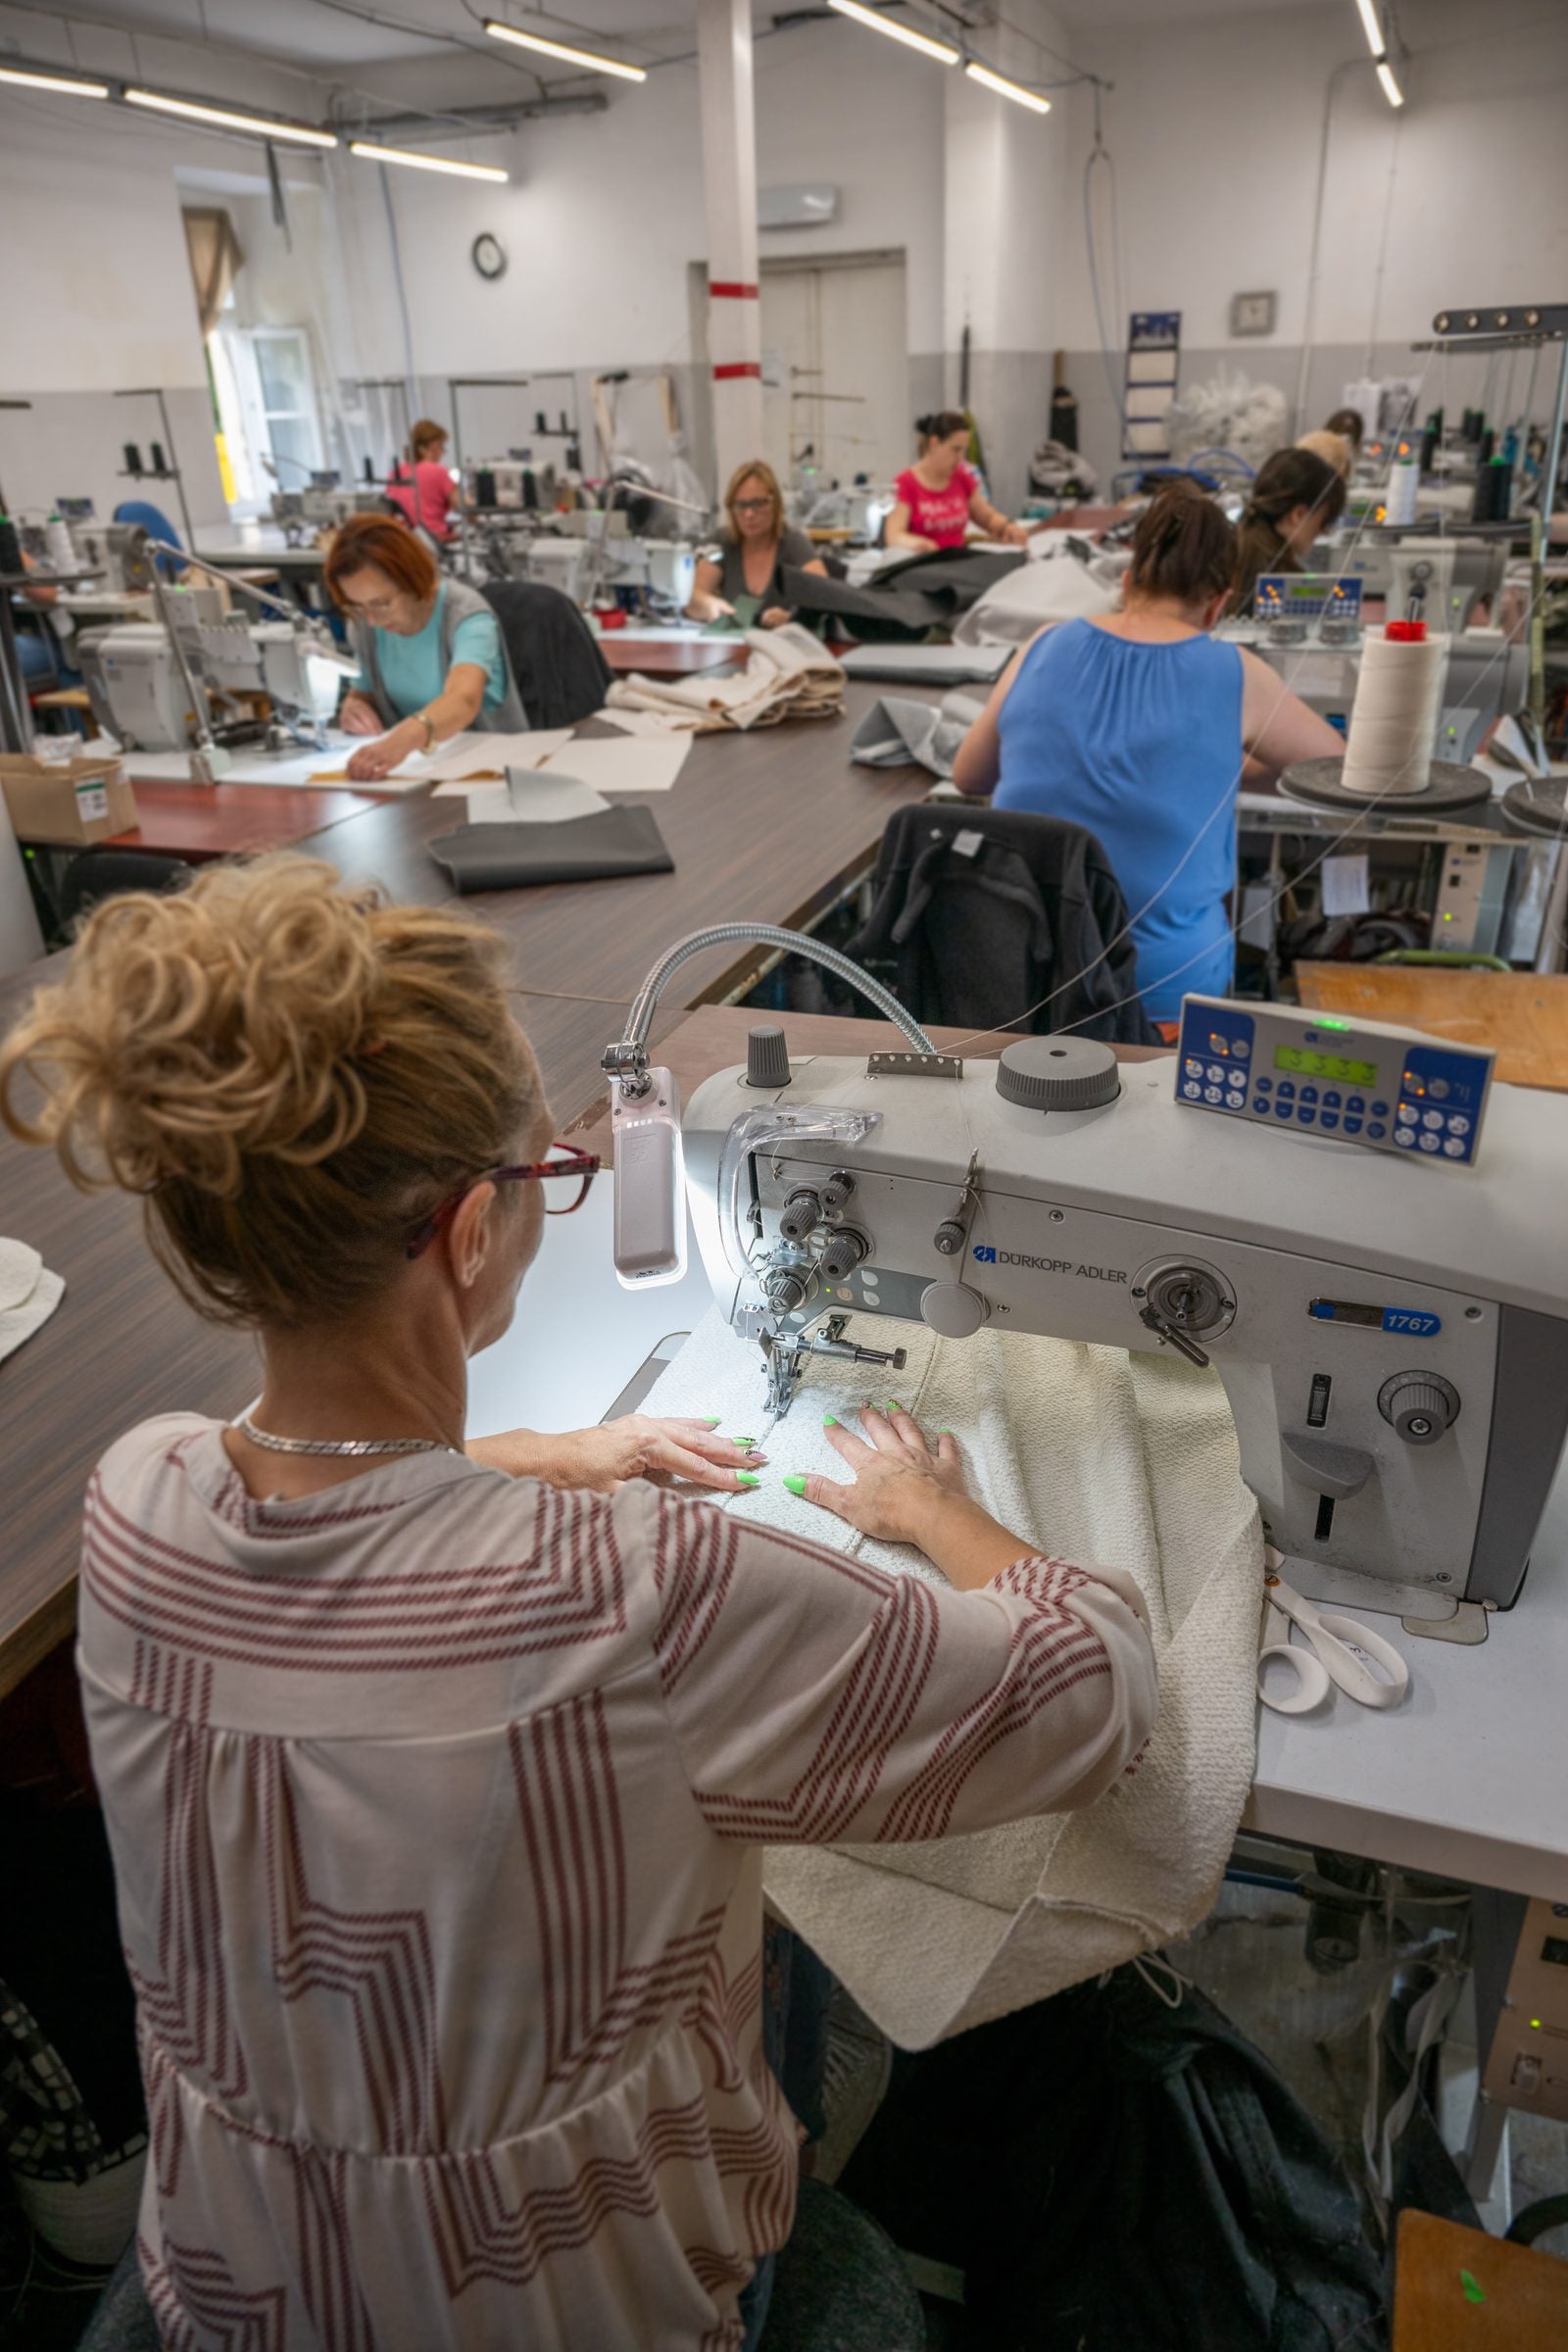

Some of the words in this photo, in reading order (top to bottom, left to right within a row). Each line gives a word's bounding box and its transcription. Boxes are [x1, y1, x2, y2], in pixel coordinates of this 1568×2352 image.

[999, 1251, 1072, 1273] DÜRKOPP
[1076, 1264, 1127, 1284] ADLER
[1388, 1314, 1435, 1332] 1767
